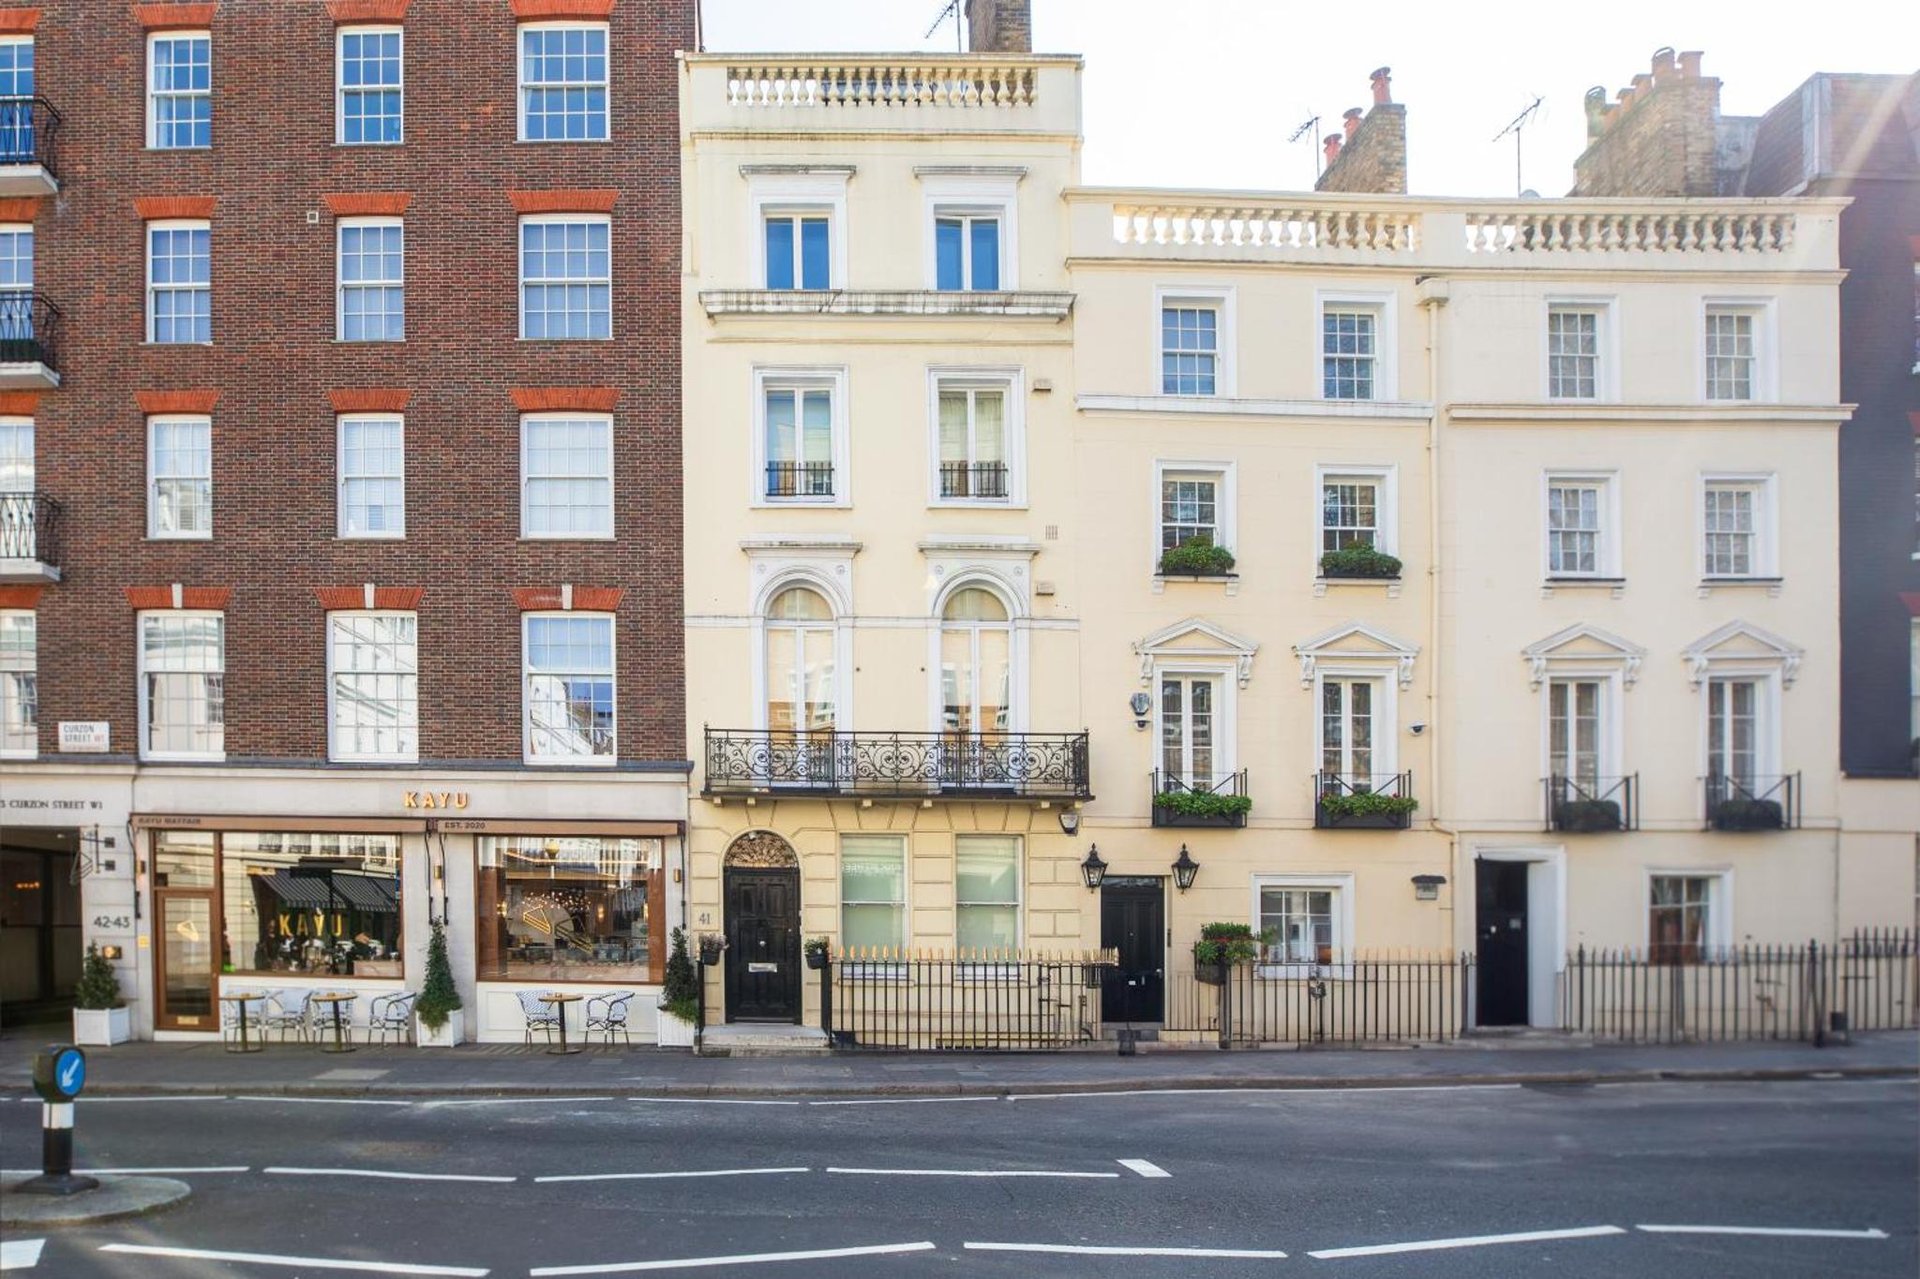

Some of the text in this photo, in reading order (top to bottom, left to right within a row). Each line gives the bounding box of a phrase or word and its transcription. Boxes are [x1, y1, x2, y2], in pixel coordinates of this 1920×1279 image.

[63, 724, 95, 733] CURZON
[64, 733, 92, 743] STREET
[9, 800, 49, 809] CURZON
[52, 800, 84, 810] STREET
[90, 801, 103, 810] W1
[404, 792, 469, 808] KAYU
[445, 821, 486, 829] EST. 2020
[699, 912, 711, 925] 41
[279, 913, 344, 937] KAYU
